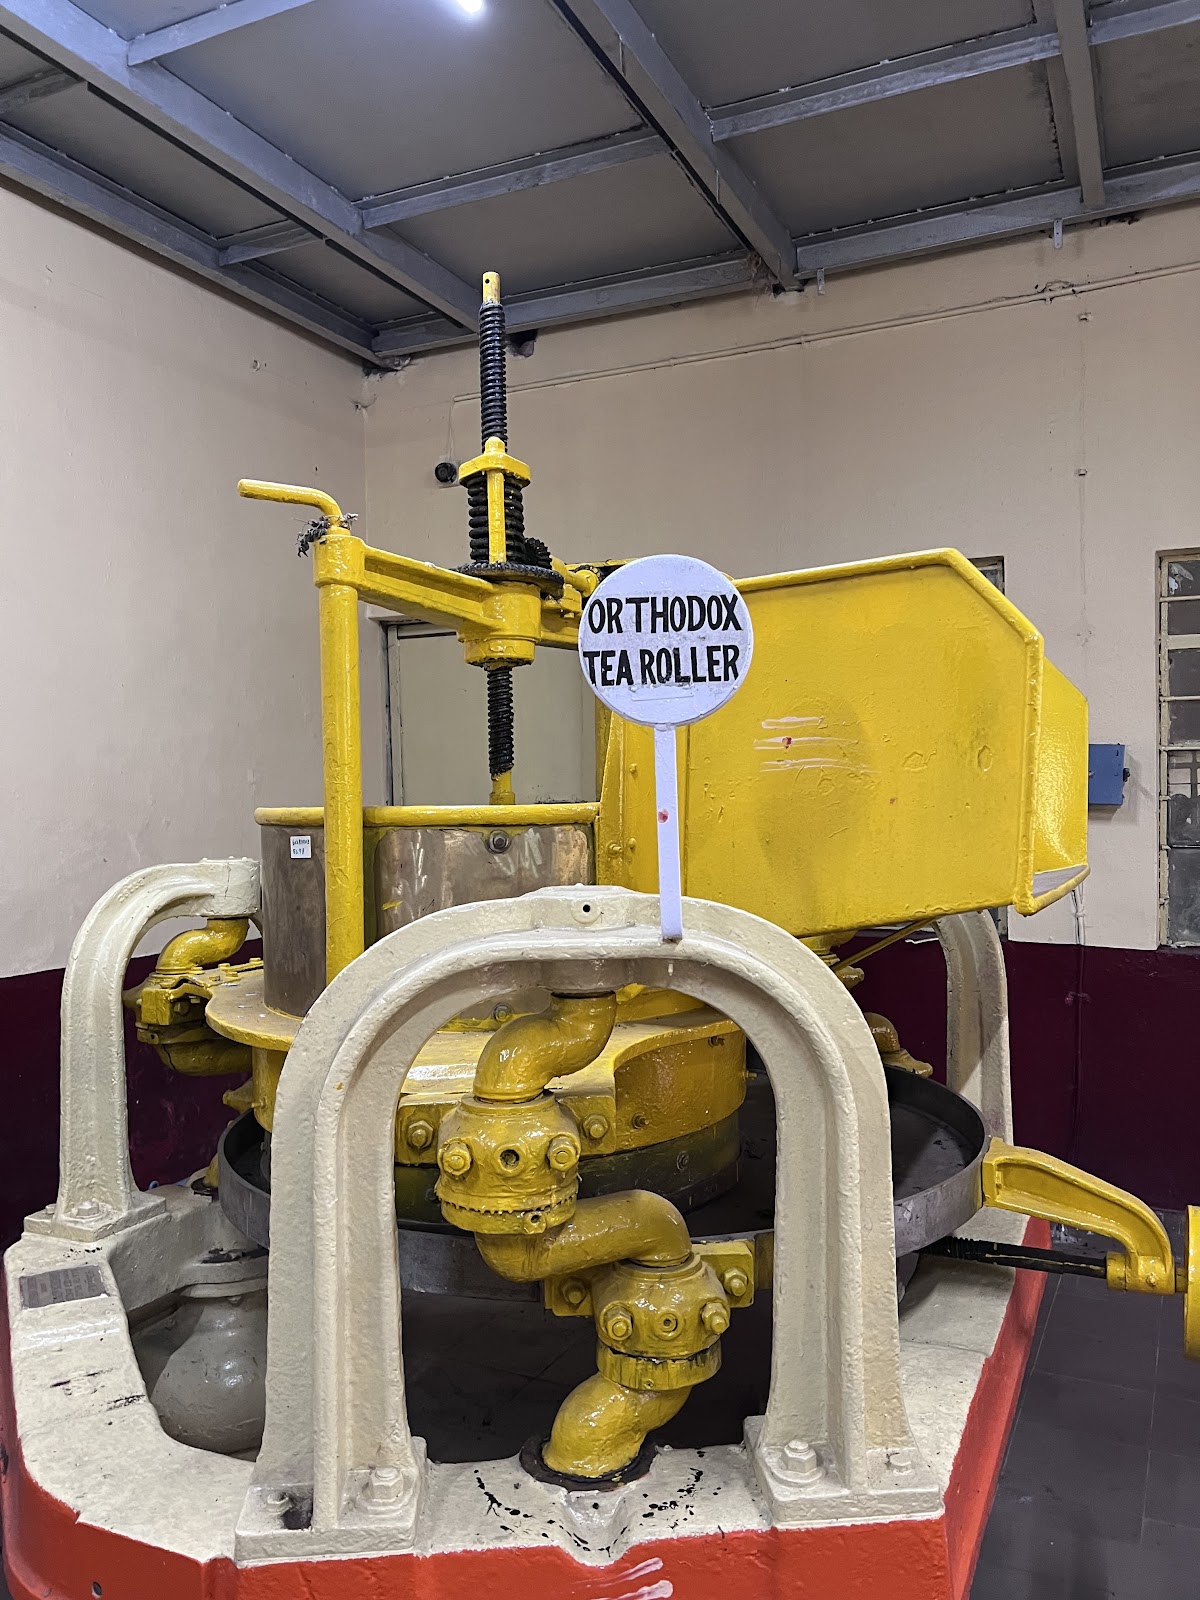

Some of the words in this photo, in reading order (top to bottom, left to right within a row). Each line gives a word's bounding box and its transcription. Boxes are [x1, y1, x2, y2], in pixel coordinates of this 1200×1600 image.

[588, 593, 742, 634] ORTHODOX
[583, 649, 634, 686] TEA
[639, 644, 740, 685] ROLLER
